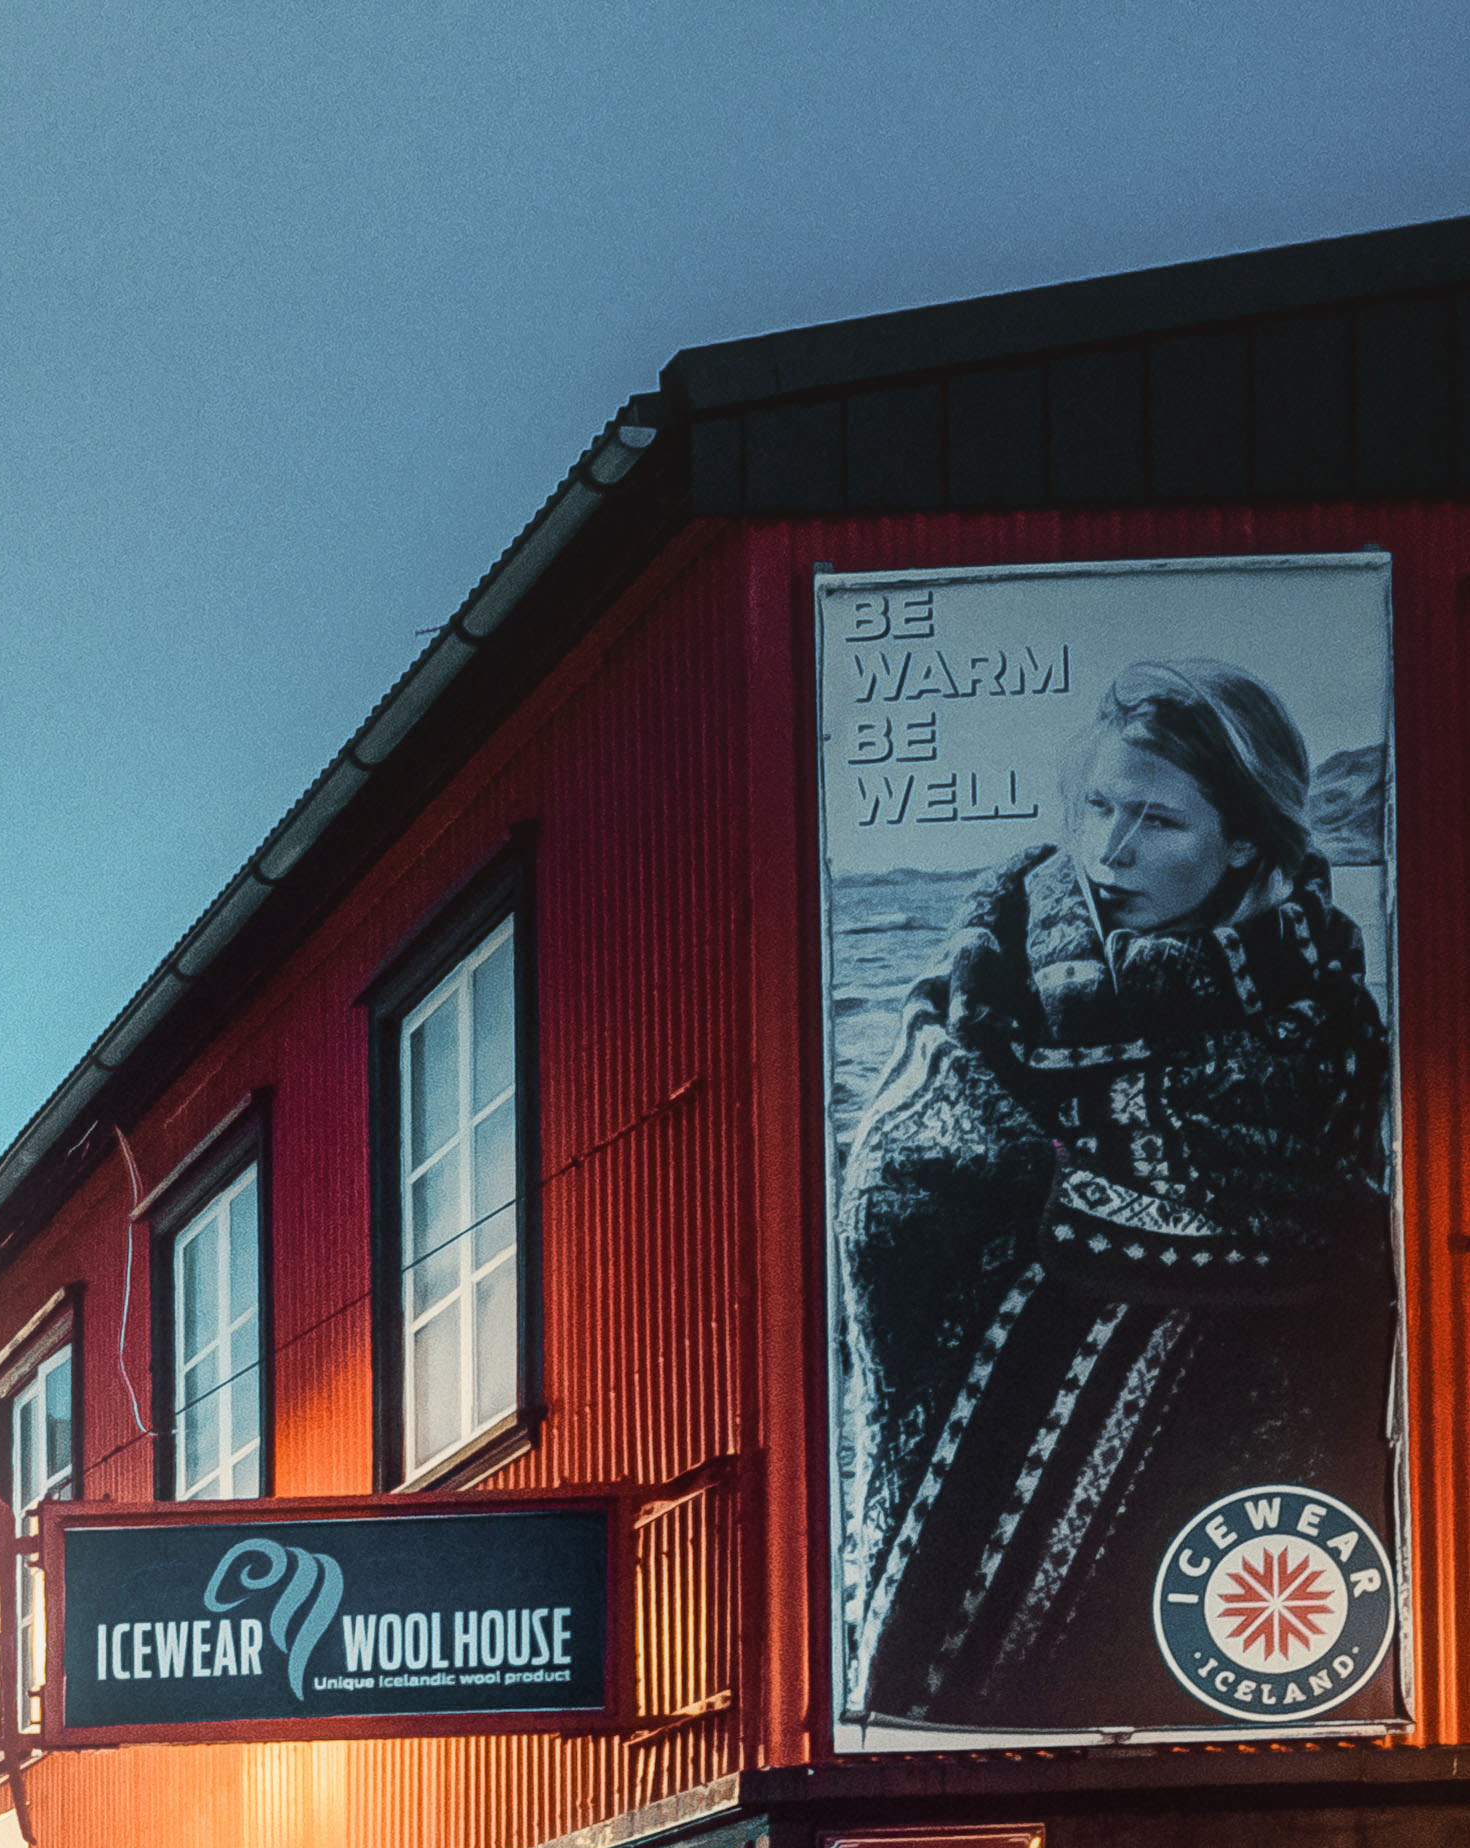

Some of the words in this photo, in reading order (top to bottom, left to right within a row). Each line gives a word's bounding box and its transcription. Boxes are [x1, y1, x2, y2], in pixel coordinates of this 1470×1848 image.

[845, 590, 934, 641] BE
[850, 644, 1070, 702] WARM
[847, 711, 938, 764] BE
[851, 769, 1038, 826] WELL
[1167, 1497, 1382, 1604] ICEWEAR
[98, 1618, 263, 1680] ICEWEAR
[313, 1676, 375, 1692] Unique
[459, 1670, 501, 1686] wool
[504, 1668, 572, 1687] product
[1197, 1653, 1356, 1705] ICELAND
